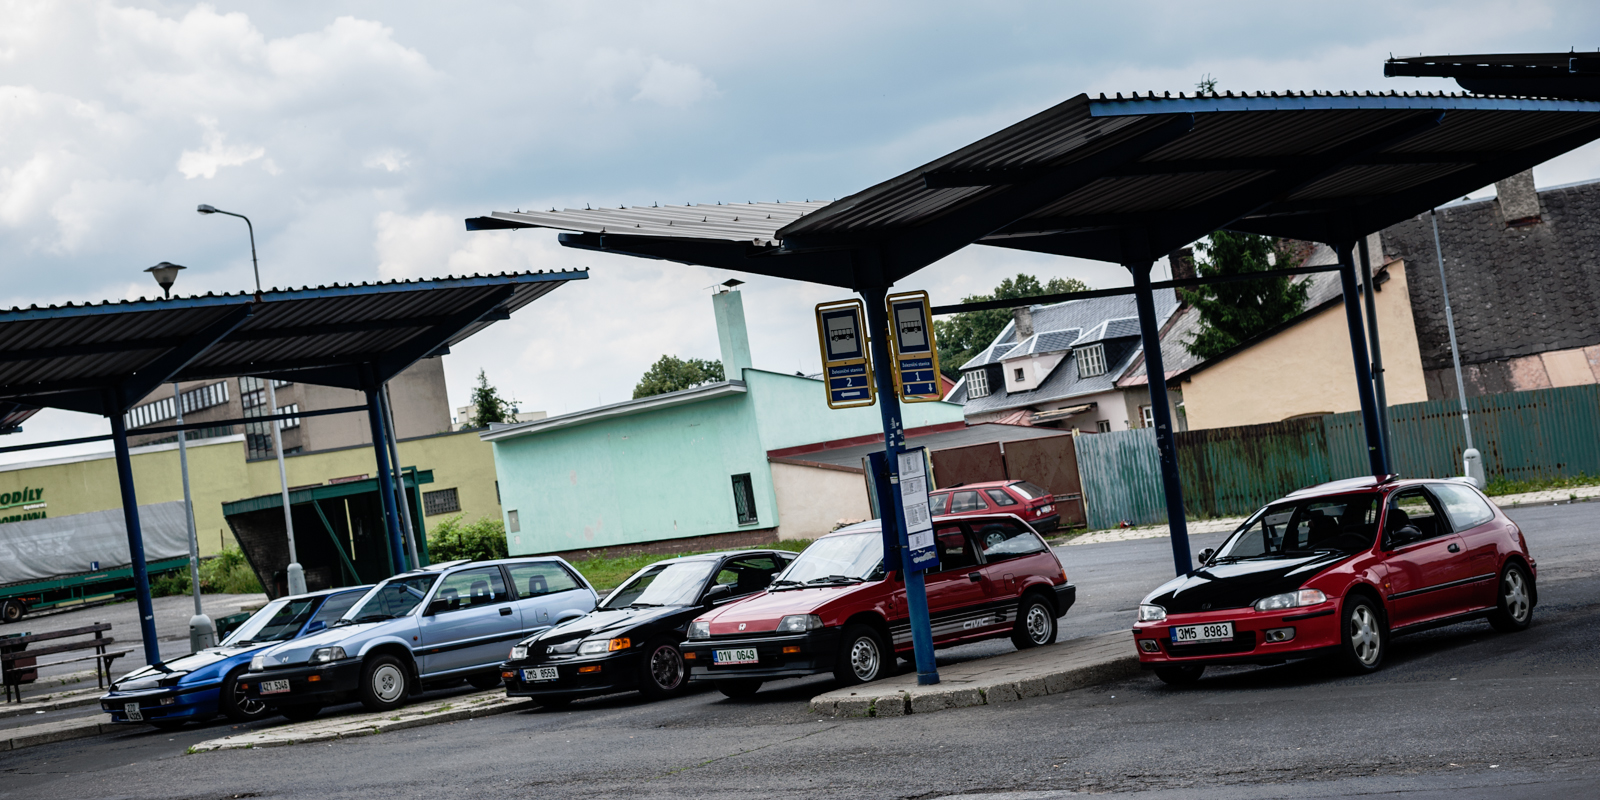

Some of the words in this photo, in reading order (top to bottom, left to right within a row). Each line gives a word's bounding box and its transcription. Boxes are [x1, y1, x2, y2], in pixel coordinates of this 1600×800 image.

[845, 377, 853, 387] 2
[914, 371, 921, 381] 1
[0, 486, 44, 505] ODÍLY
[0, 511, 47, 524] OPRAVNA
[91, 562, 98, 571] L
[963, 617, 989, 630] CIVIC
[994, 609, 1008, 623] S
[1178, 627, 1197, 640] 3M5
[1203, 624, 1229, 638] 8983
[718, 650, 732, 661] 01V
[736, 649, 755, 660] 0649
[525, 669, 537, 680] 2M9
[540, 668, 556, 678] 8559
[274, 680, 288, 690] 5346
